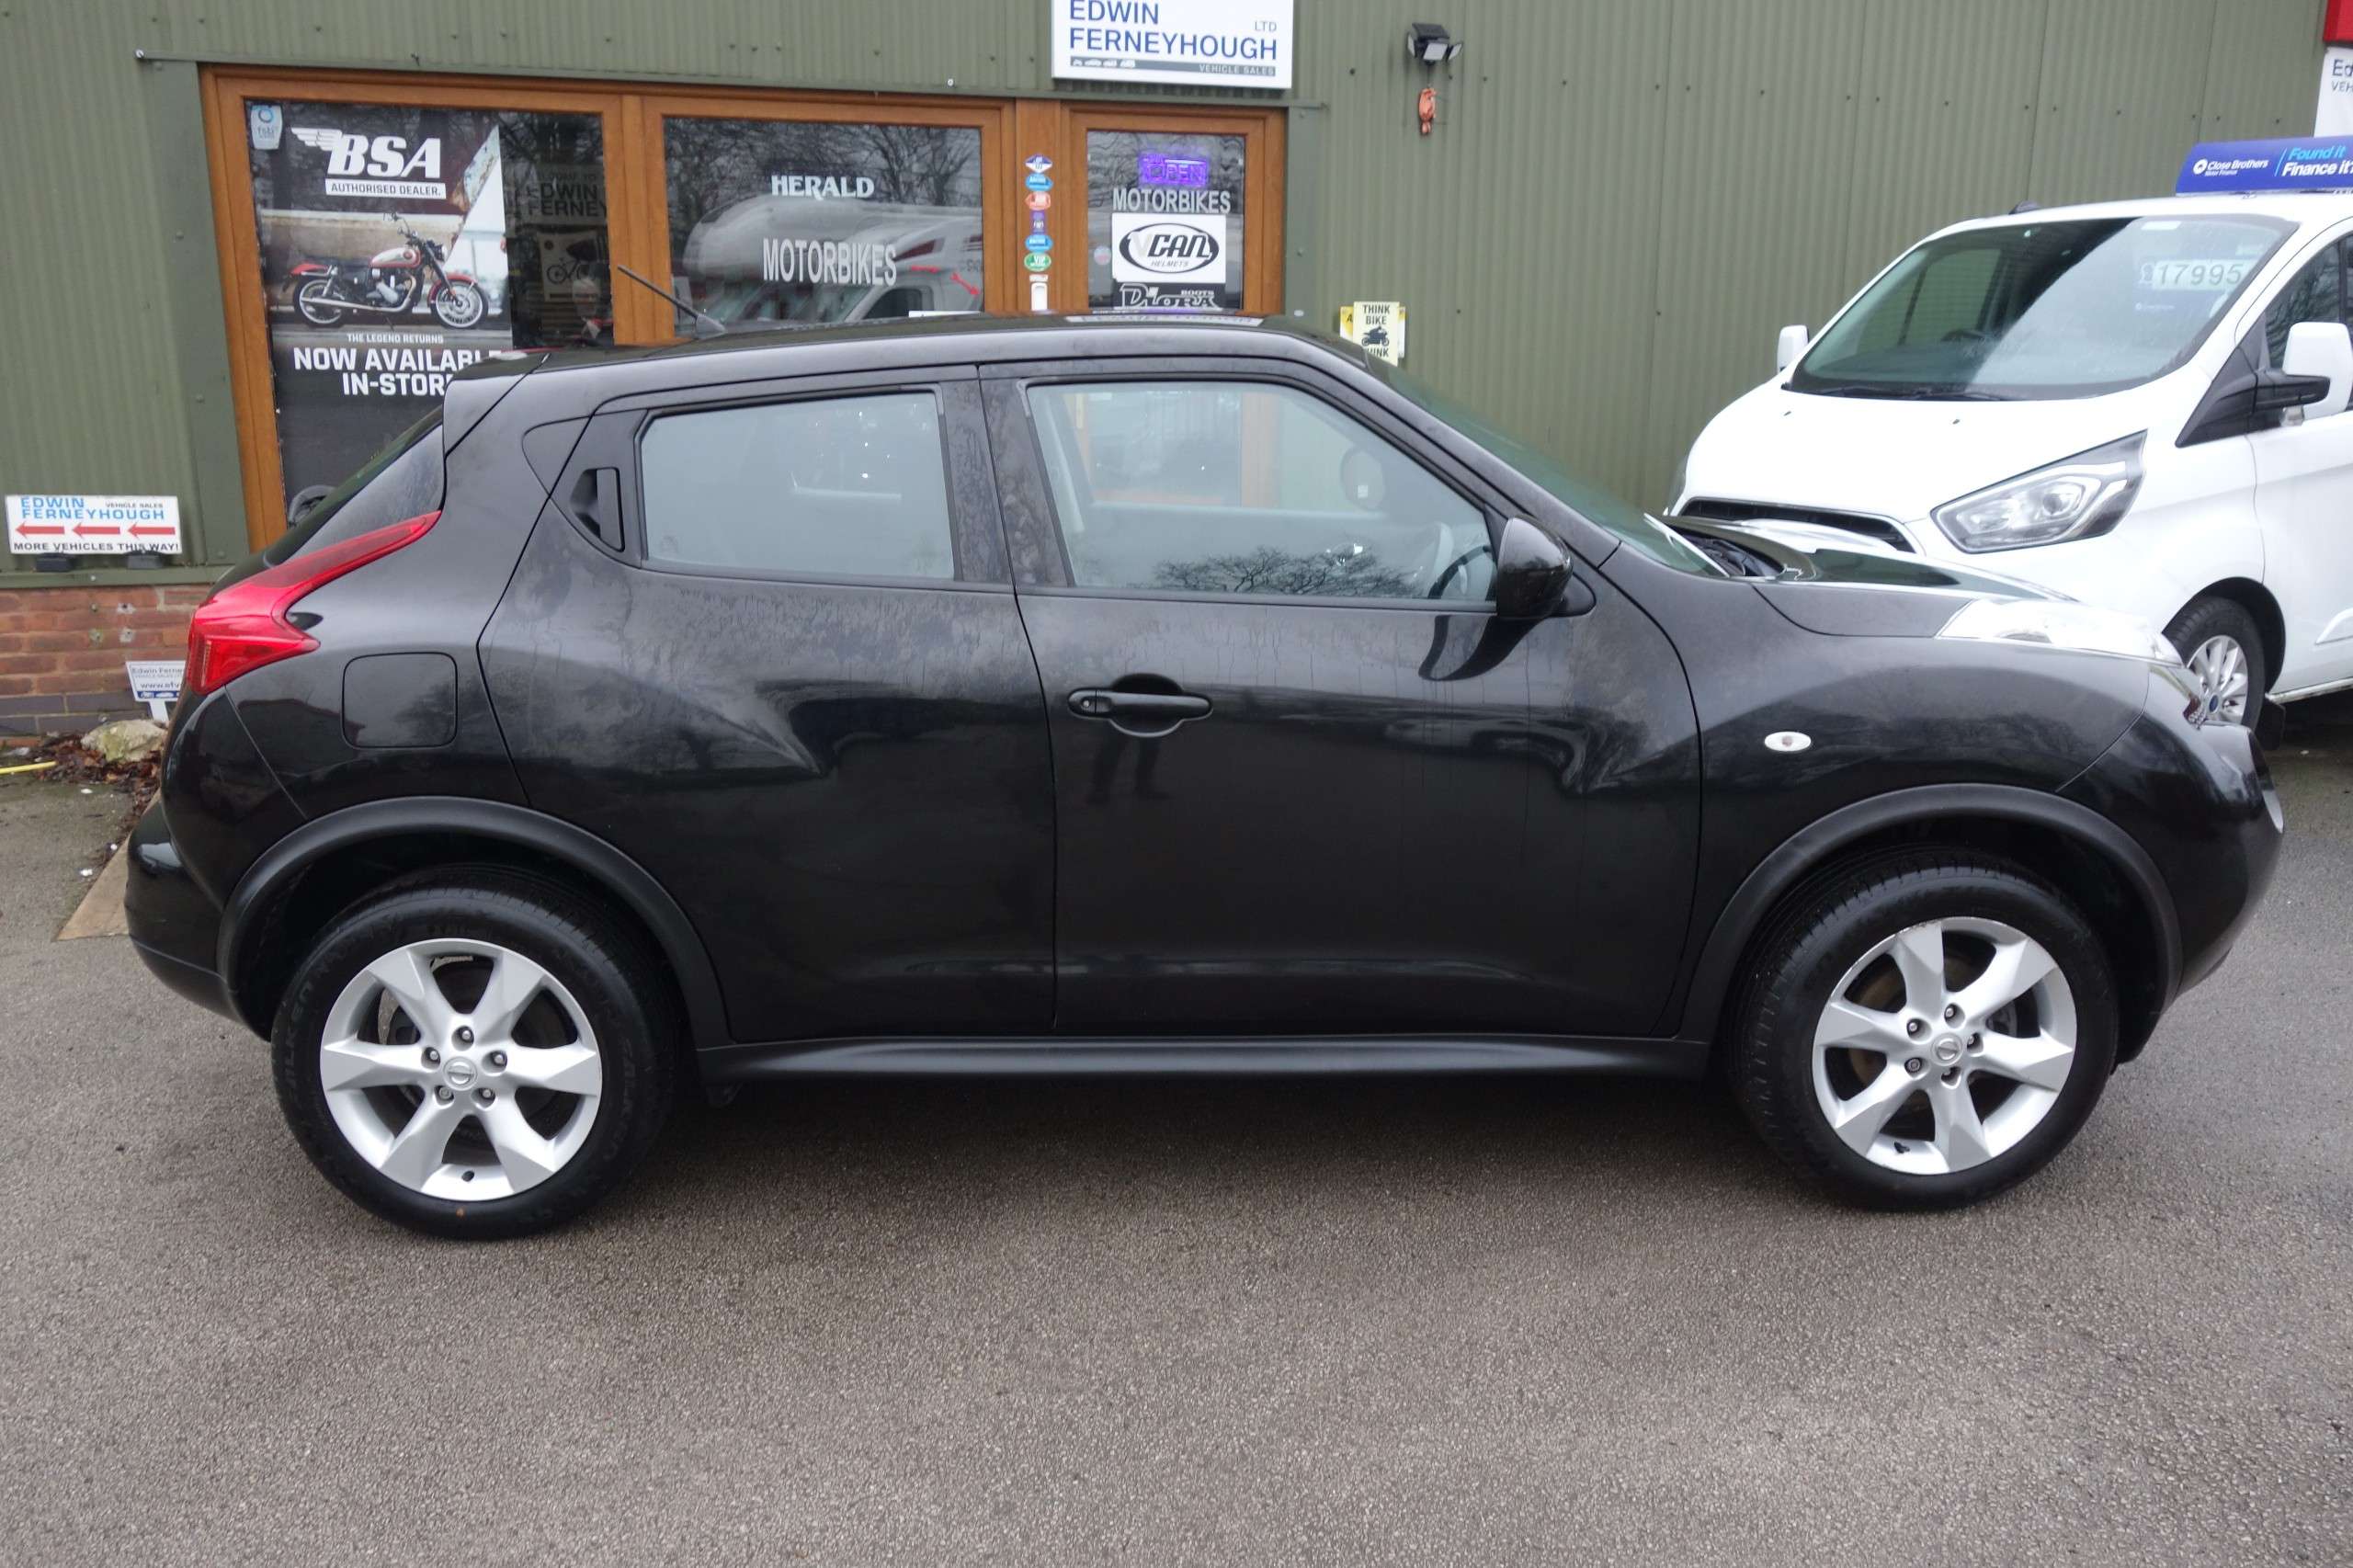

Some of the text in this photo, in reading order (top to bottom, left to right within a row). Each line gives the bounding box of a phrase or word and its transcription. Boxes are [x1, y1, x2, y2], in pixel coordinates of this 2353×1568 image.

[1070, 0, 1159, 25] EDWIN
[1254, 20, 1277, 32] LTD
[1069, 27, 1277, 61] FERNEYHOUGH
[1199, 63, 1275, 76] VEHICLE SALES
[327, 133, 441, 178] BSA
[2288, 145, 2334, 161] Found
[2208, 158, 2269, 171] Close Brothers
[2282, 162, 2337, 176] Finance
[1146, 164, 1206, 185] OPEN
[331, 183, 396, 195] AUTHORISED
[771, 175, 875, 200] HERALD
[1113, 187, 1232, 214] MOTORBIKES
[763, 238, 897, 286] MOTORBIKES
[1362, 304, 1391, 314] THINK
[1365, 315, 1387, 325] BIKE
[347, 333, 445, 345] THE LEGEND RETURNS
[293, 347, 502, 372] NOW AVAILAB
[342, 372, 453, 397] IN-STOR
[20, 496, 85, 508] EDWIN
[22, 508, 165, 520] FERNEYHOUGH
[14, 542, 179, 551] MORE VEHICLES THIS WAY!
